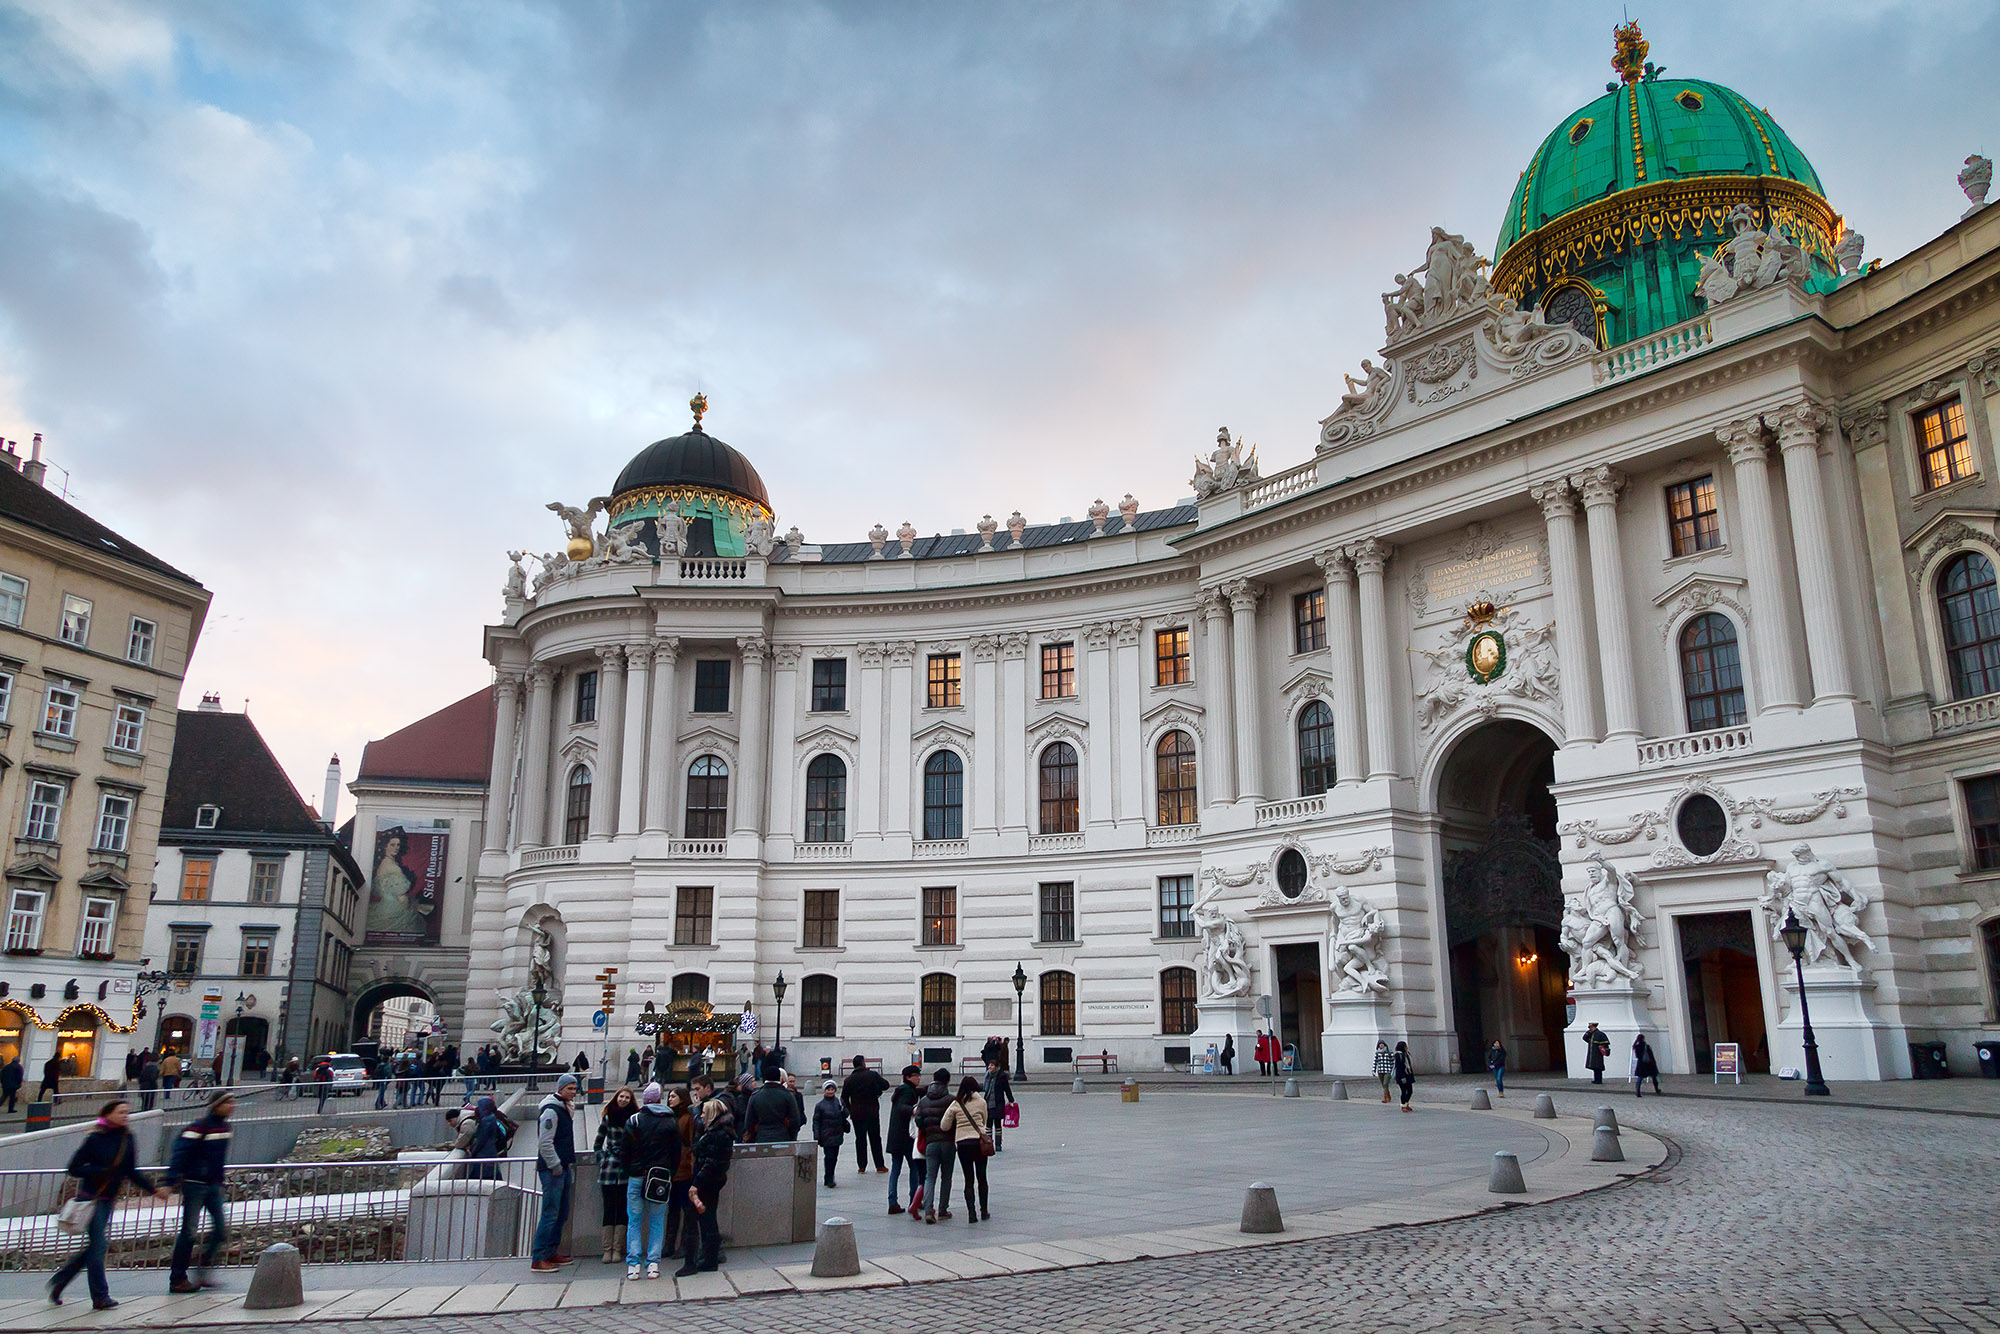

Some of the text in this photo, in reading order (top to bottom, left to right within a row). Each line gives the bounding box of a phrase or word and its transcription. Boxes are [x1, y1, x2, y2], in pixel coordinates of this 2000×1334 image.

[423, 835, 439, 899] Sisi Museum
[669, 1000, 711, 1012] PUNSCH
